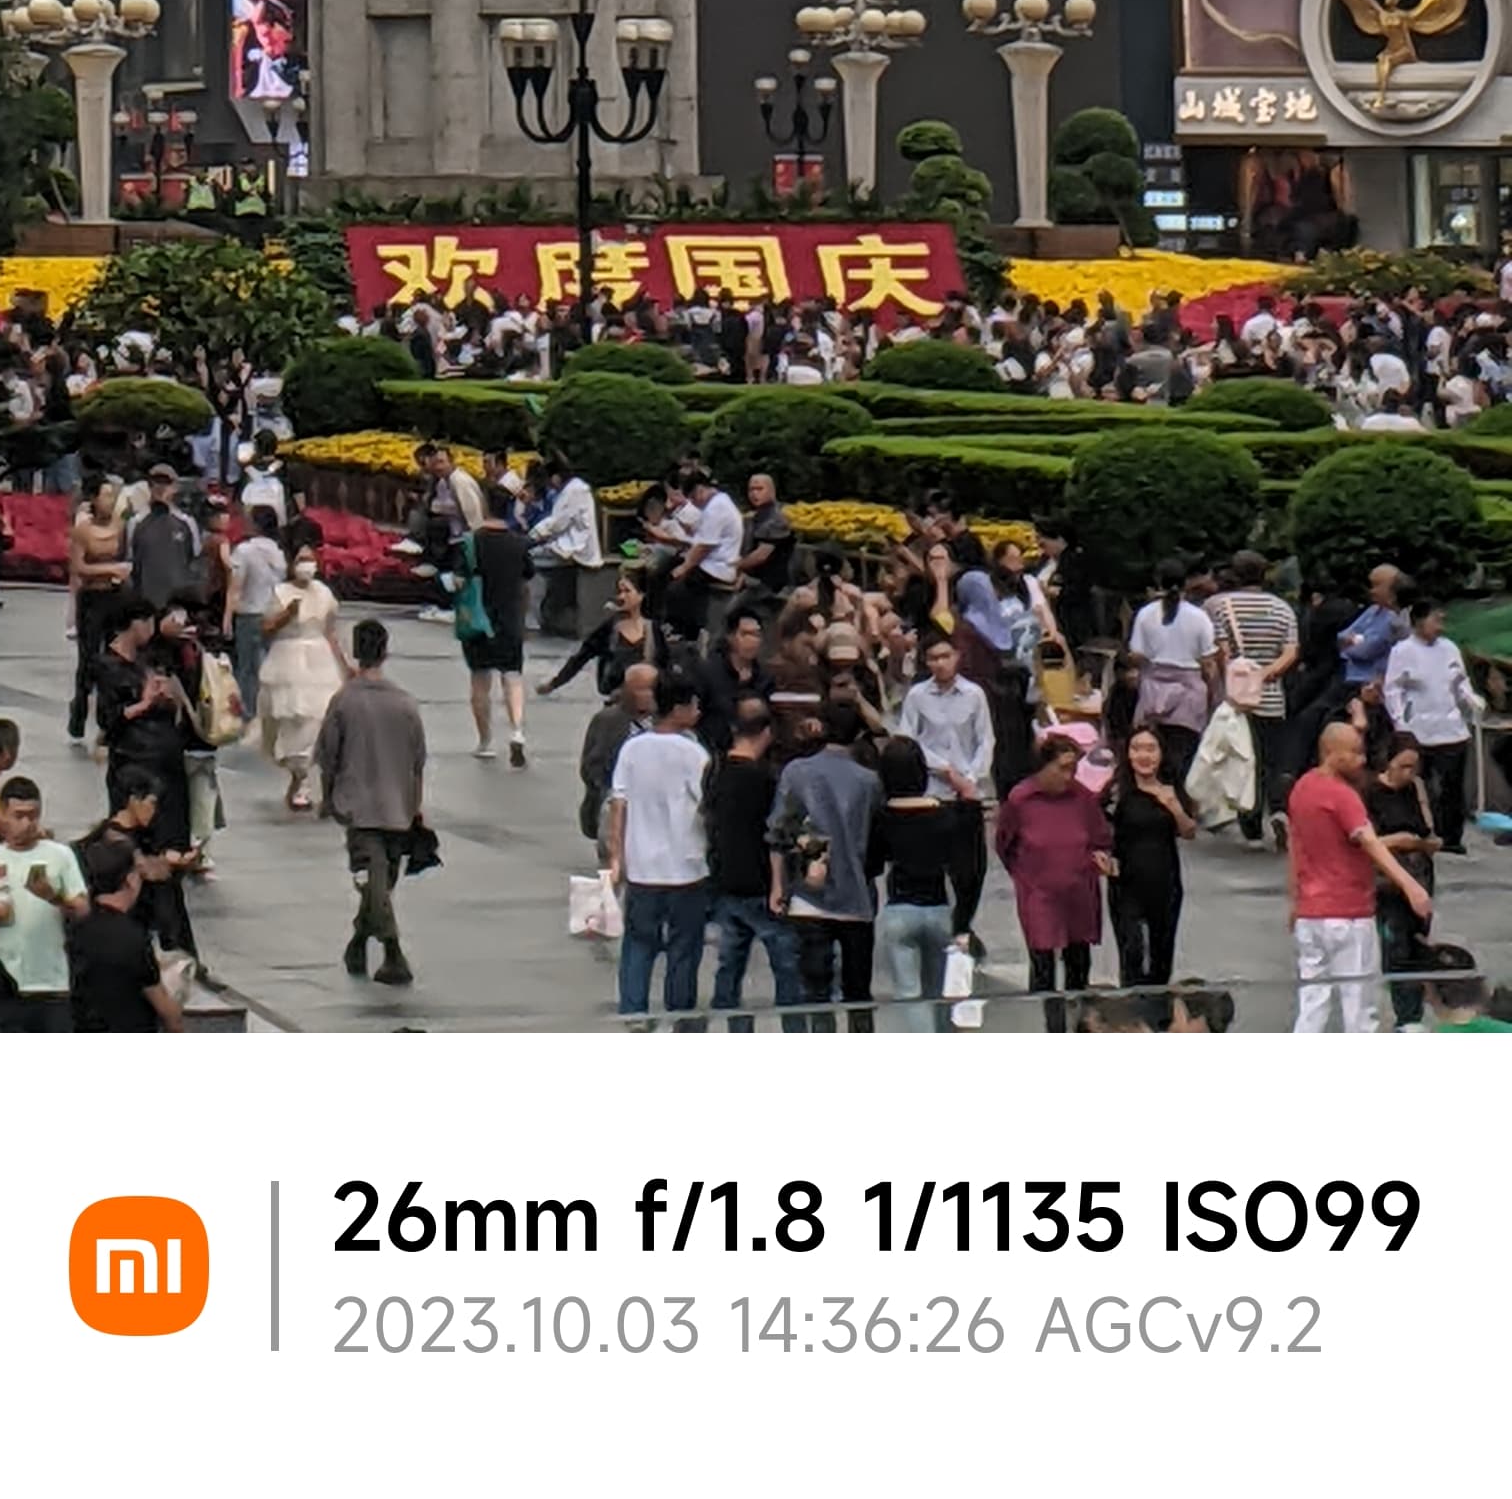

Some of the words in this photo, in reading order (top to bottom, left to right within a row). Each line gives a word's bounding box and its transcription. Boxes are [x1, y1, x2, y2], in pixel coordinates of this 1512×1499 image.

[1178, 86, 1318, 124] 山城宝地
[377, 233, 946, 317] 欢度国庆
